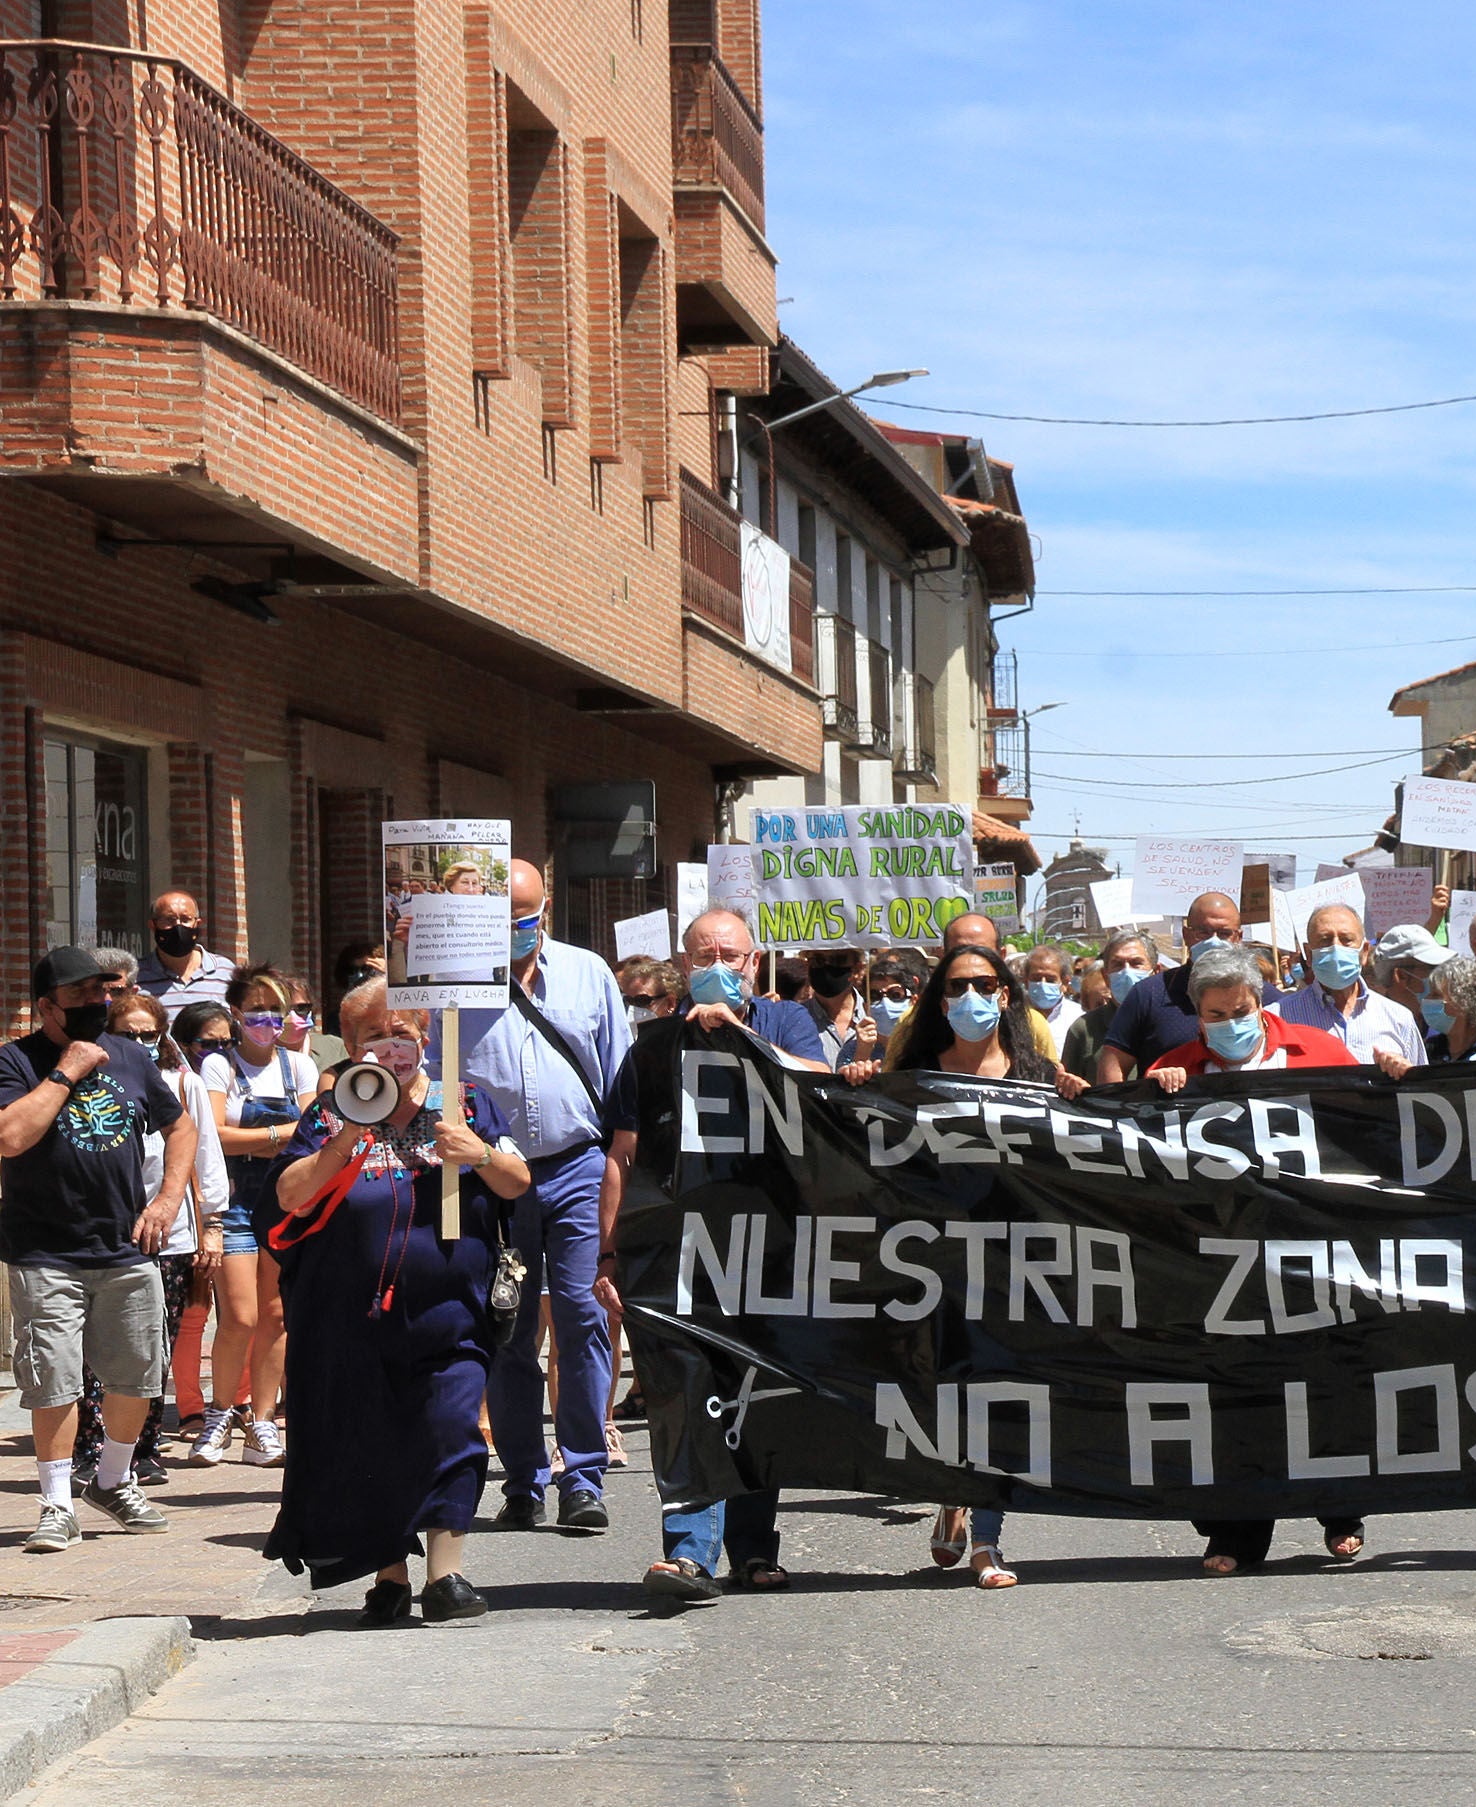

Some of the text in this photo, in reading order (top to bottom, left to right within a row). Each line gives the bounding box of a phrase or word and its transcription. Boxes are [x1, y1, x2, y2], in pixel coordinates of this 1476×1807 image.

[755, 814, 797, 843] POR
[806, 813, 848, 839] UNA
[869, 846, 964, 878] RURAL
[758, 899, 846, 943] NAVAS
[856, 904, 884, 934] DE
[394, 987, 505, 1003] NAVA EN LUCHA
[680, 1048, 805, 1157] EN
[855, 1096, 1321, 1182] DEFENSA
[675, 1211, 1137, 1329] NUESTRA
[1199, 1237, 1466, 1336] ZONA
[875, 1381, 1052, 1488] NO
[1125, 1382, 1215, 1486] A
